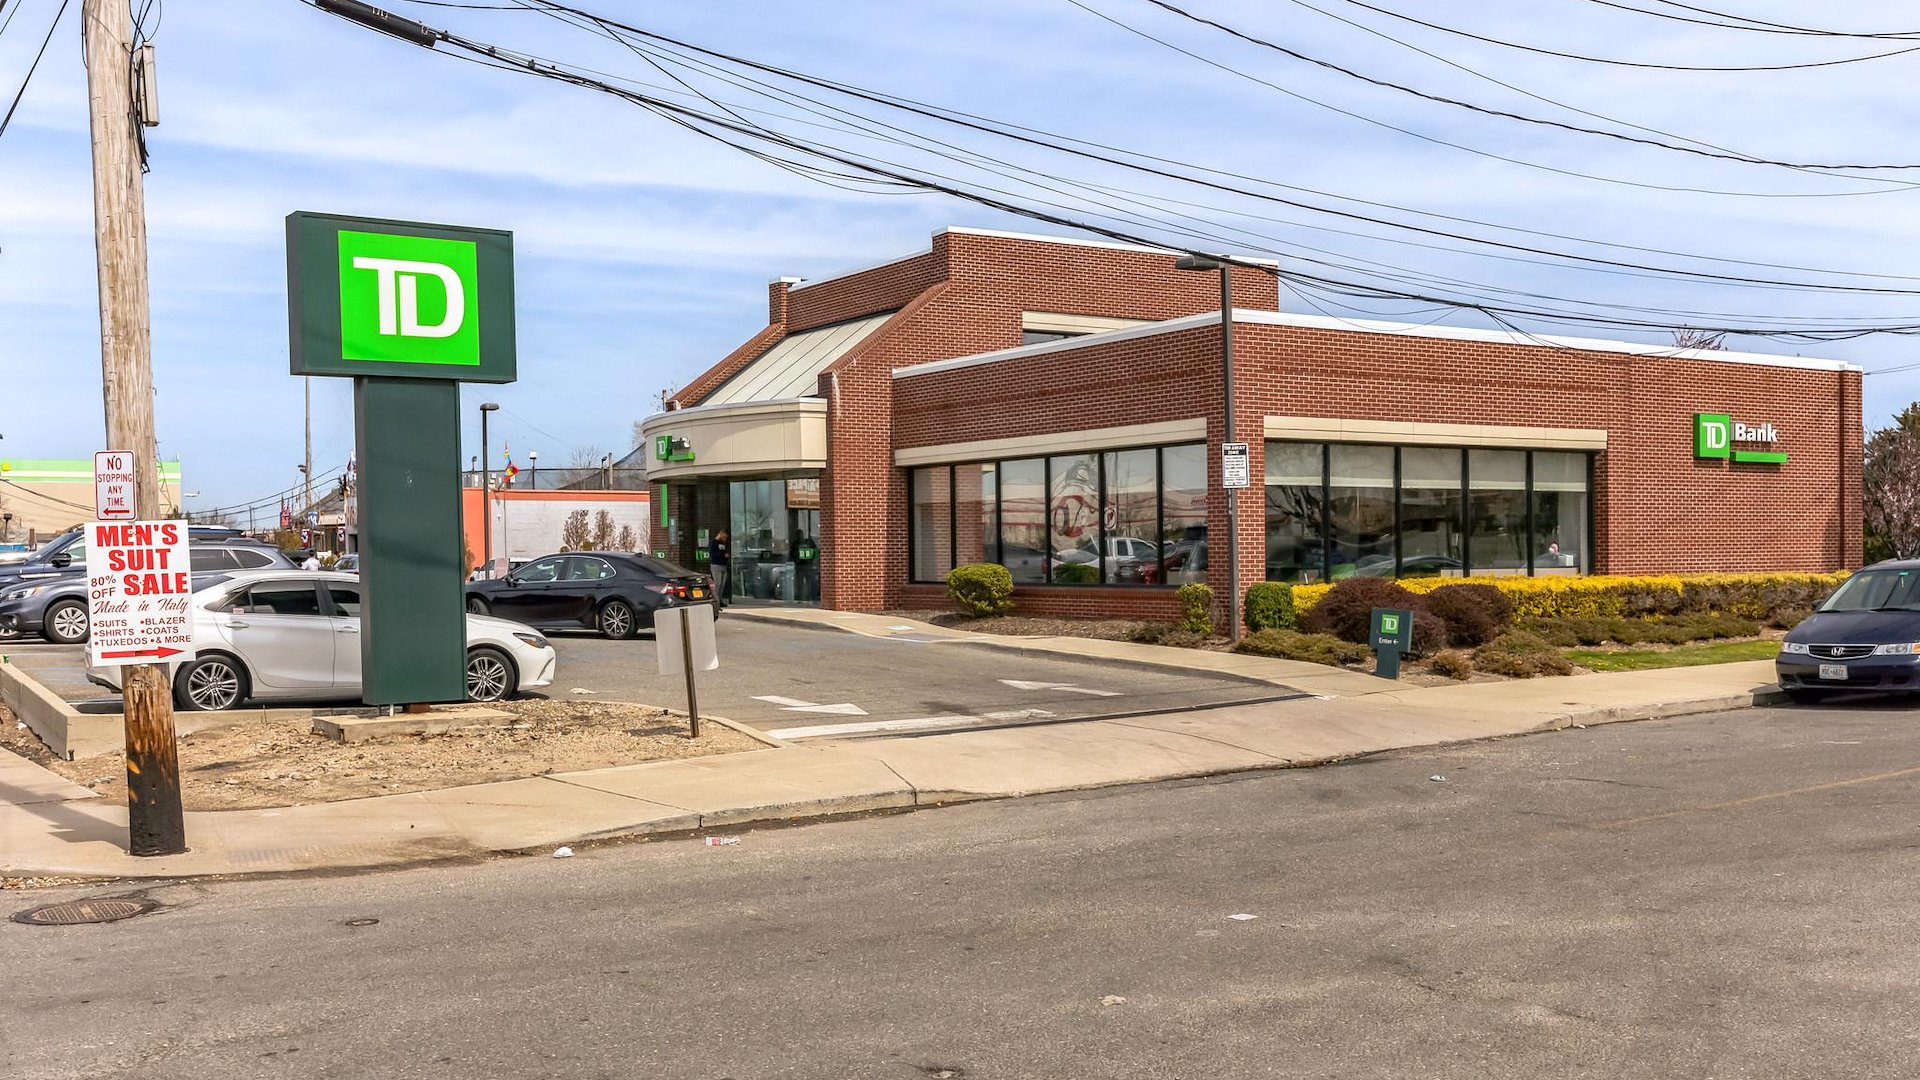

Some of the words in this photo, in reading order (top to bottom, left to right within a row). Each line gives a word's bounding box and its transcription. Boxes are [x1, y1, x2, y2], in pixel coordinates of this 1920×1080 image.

[353, 256, 465, 338] TD
[1702, 422, 1727, 449] TD
[1735, 423, 1778, 442] Bank
[107, 457, 122, 471] NO
[98, 473, 133, 483] STOPPING
[107, 485, 123, 494] ANY
[107, 498, 124, 507] TIME
[96, 524, 178, 547] MEN'S
[108, 548, 171, 571] SUIT
[91, 575, 117, 587] 80%
[123, 572, 188, 596] SALE
[91, 587, 116, 599] OFF
[93, 600, 129, 614] Made
[138, 600, 150, 612] in
[157, 597, 189, 614] Italy
[98, 619, 127, 628] SUITS
[145, 616, 186, 626] BLAZER
[1383, 618, 1397, 630] TD
[99, 628, 135, 637] SHIRTS
[146, 626, 179, 635] COATS
[100, 637, 148, 646] TUXEDOS
[155, 636, 162, 644] &
[165, 635, 192, 644] MORE
